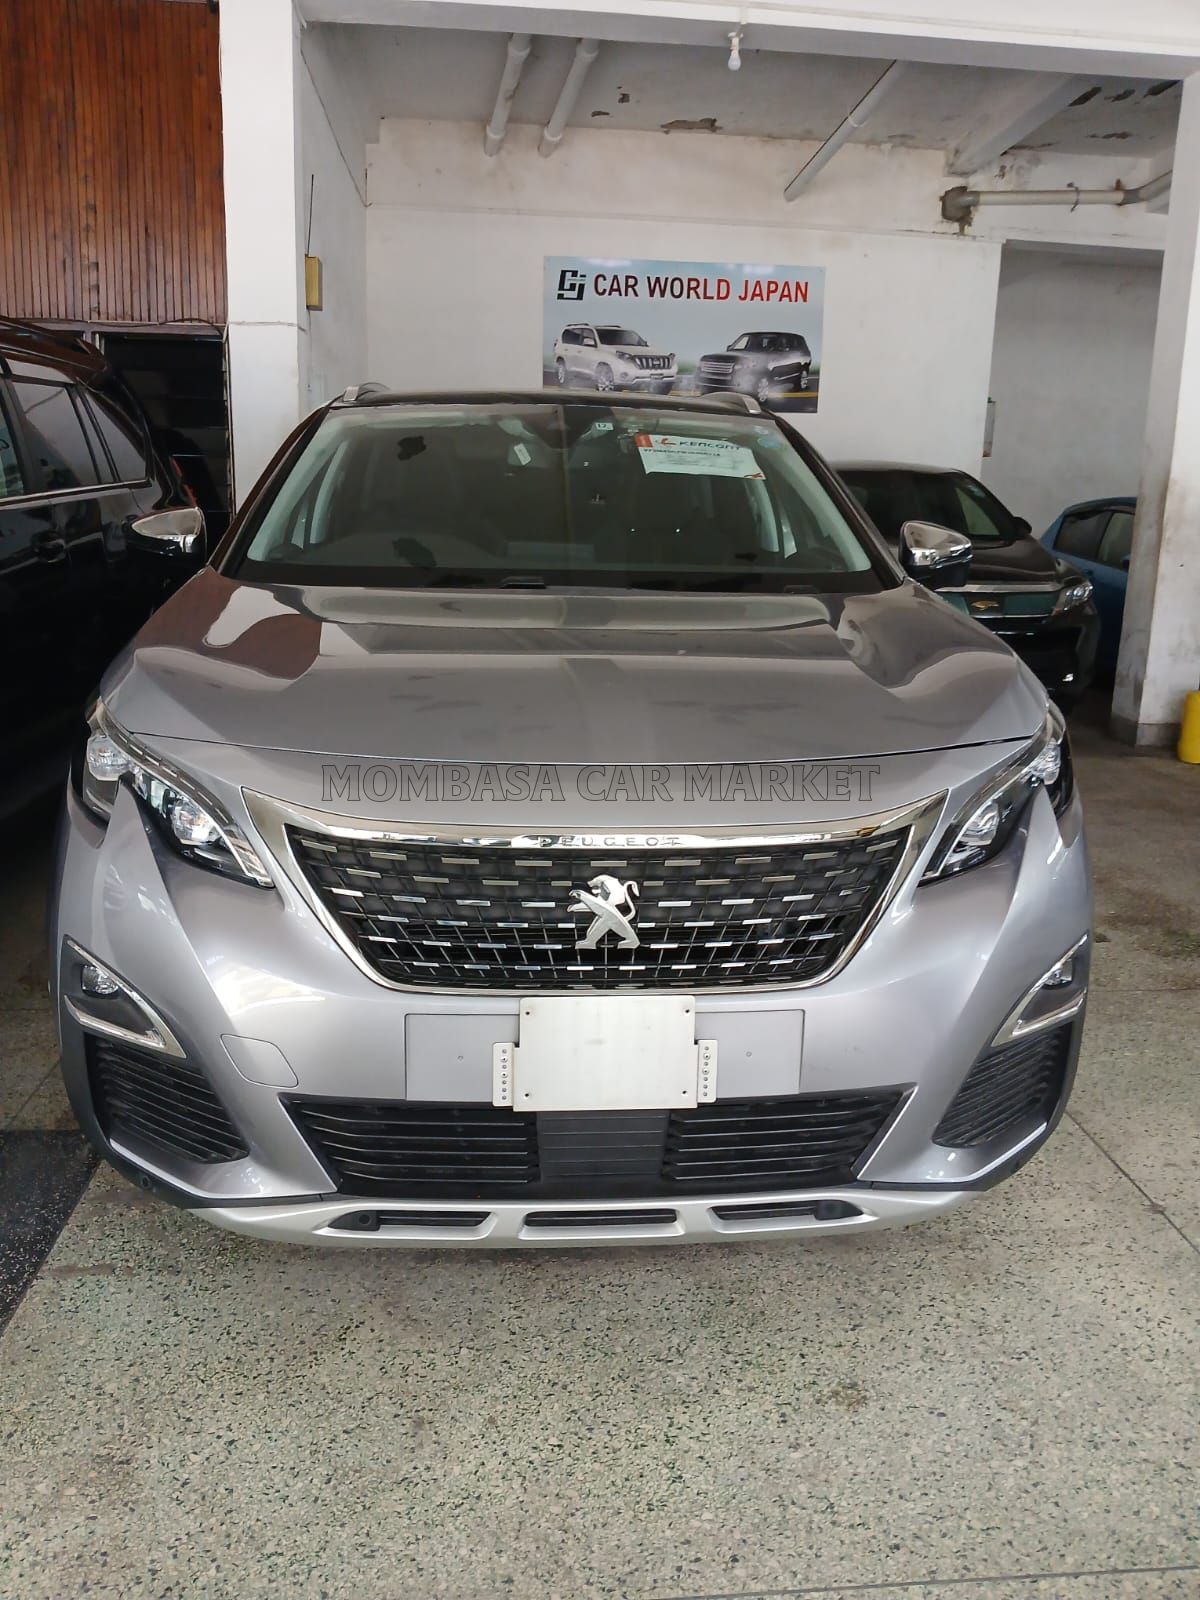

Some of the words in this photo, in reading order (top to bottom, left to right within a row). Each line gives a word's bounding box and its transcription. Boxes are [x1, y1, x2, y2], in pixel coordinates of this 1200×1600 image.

[594, 273, 640, 298] CAR
[647, 276, 731, 300] WORLD
[738, 279, 809, 303] JAPAN
[540, 836, 680, 848] PEUGEOT
